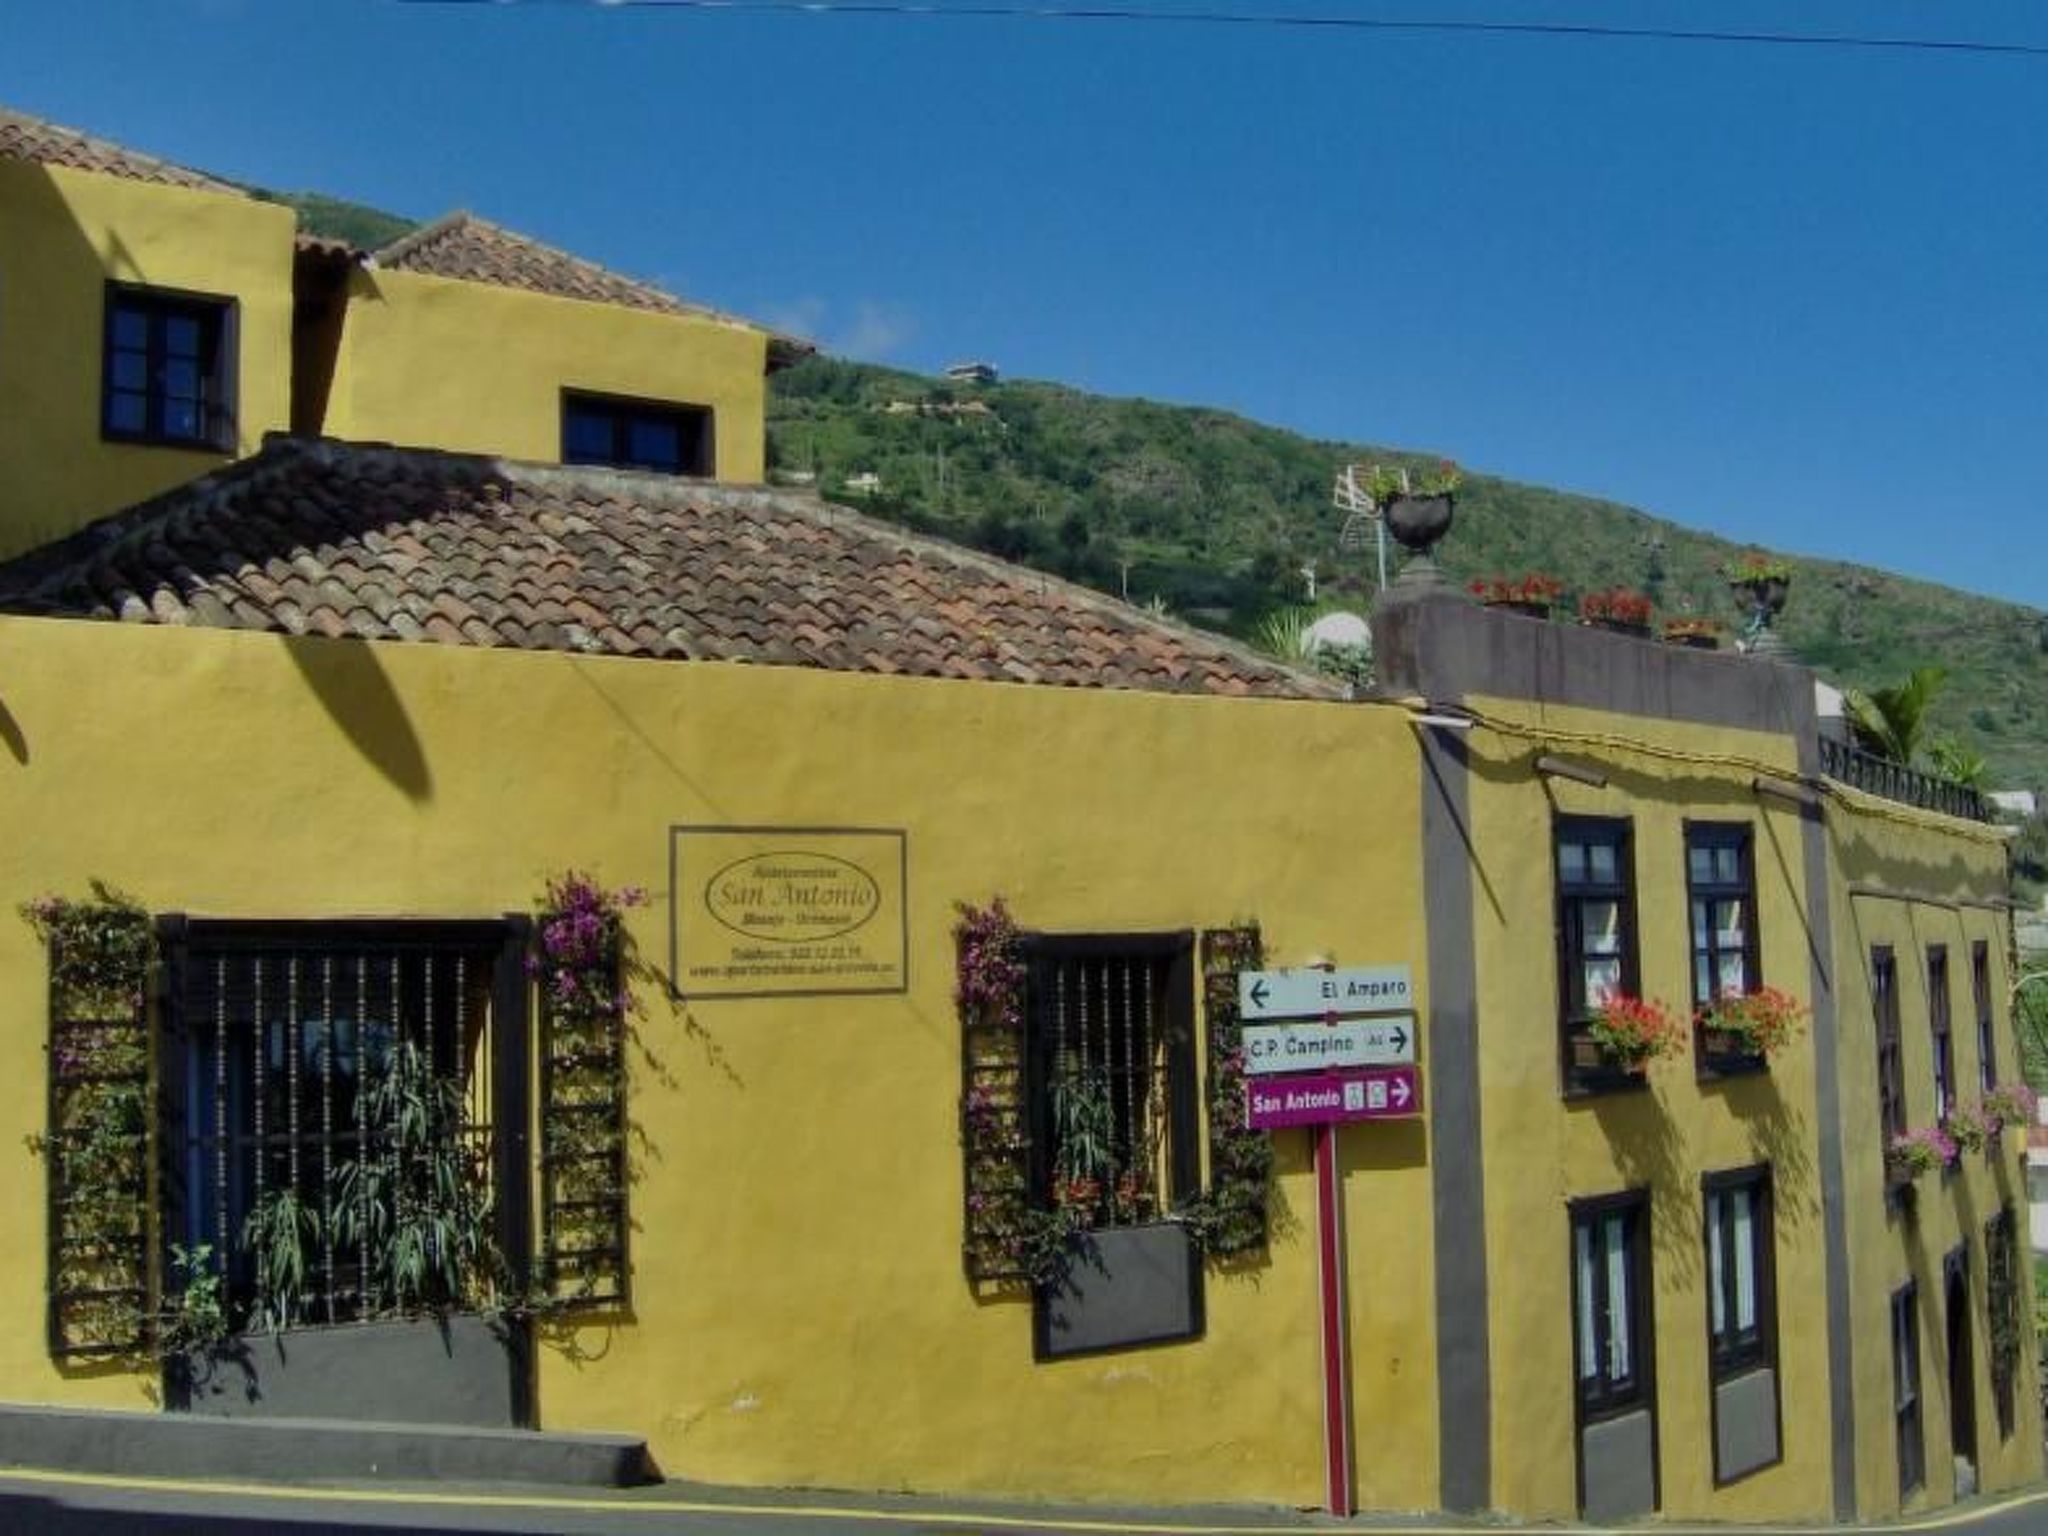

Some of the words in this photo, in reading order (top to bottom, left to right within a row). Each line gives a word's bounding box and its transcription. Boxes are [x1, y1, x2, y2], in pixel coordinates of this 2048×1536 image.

[720, 881, 765, 907] San
[772, 881, 873, 907] Antonio
[1322, 981, 1338, 999] El
[1348, 980, 1407, 1000] Amparo
[1253, 1095, 1281, 1113] San
[1286, 1089, 1341, 1110] Antonio
